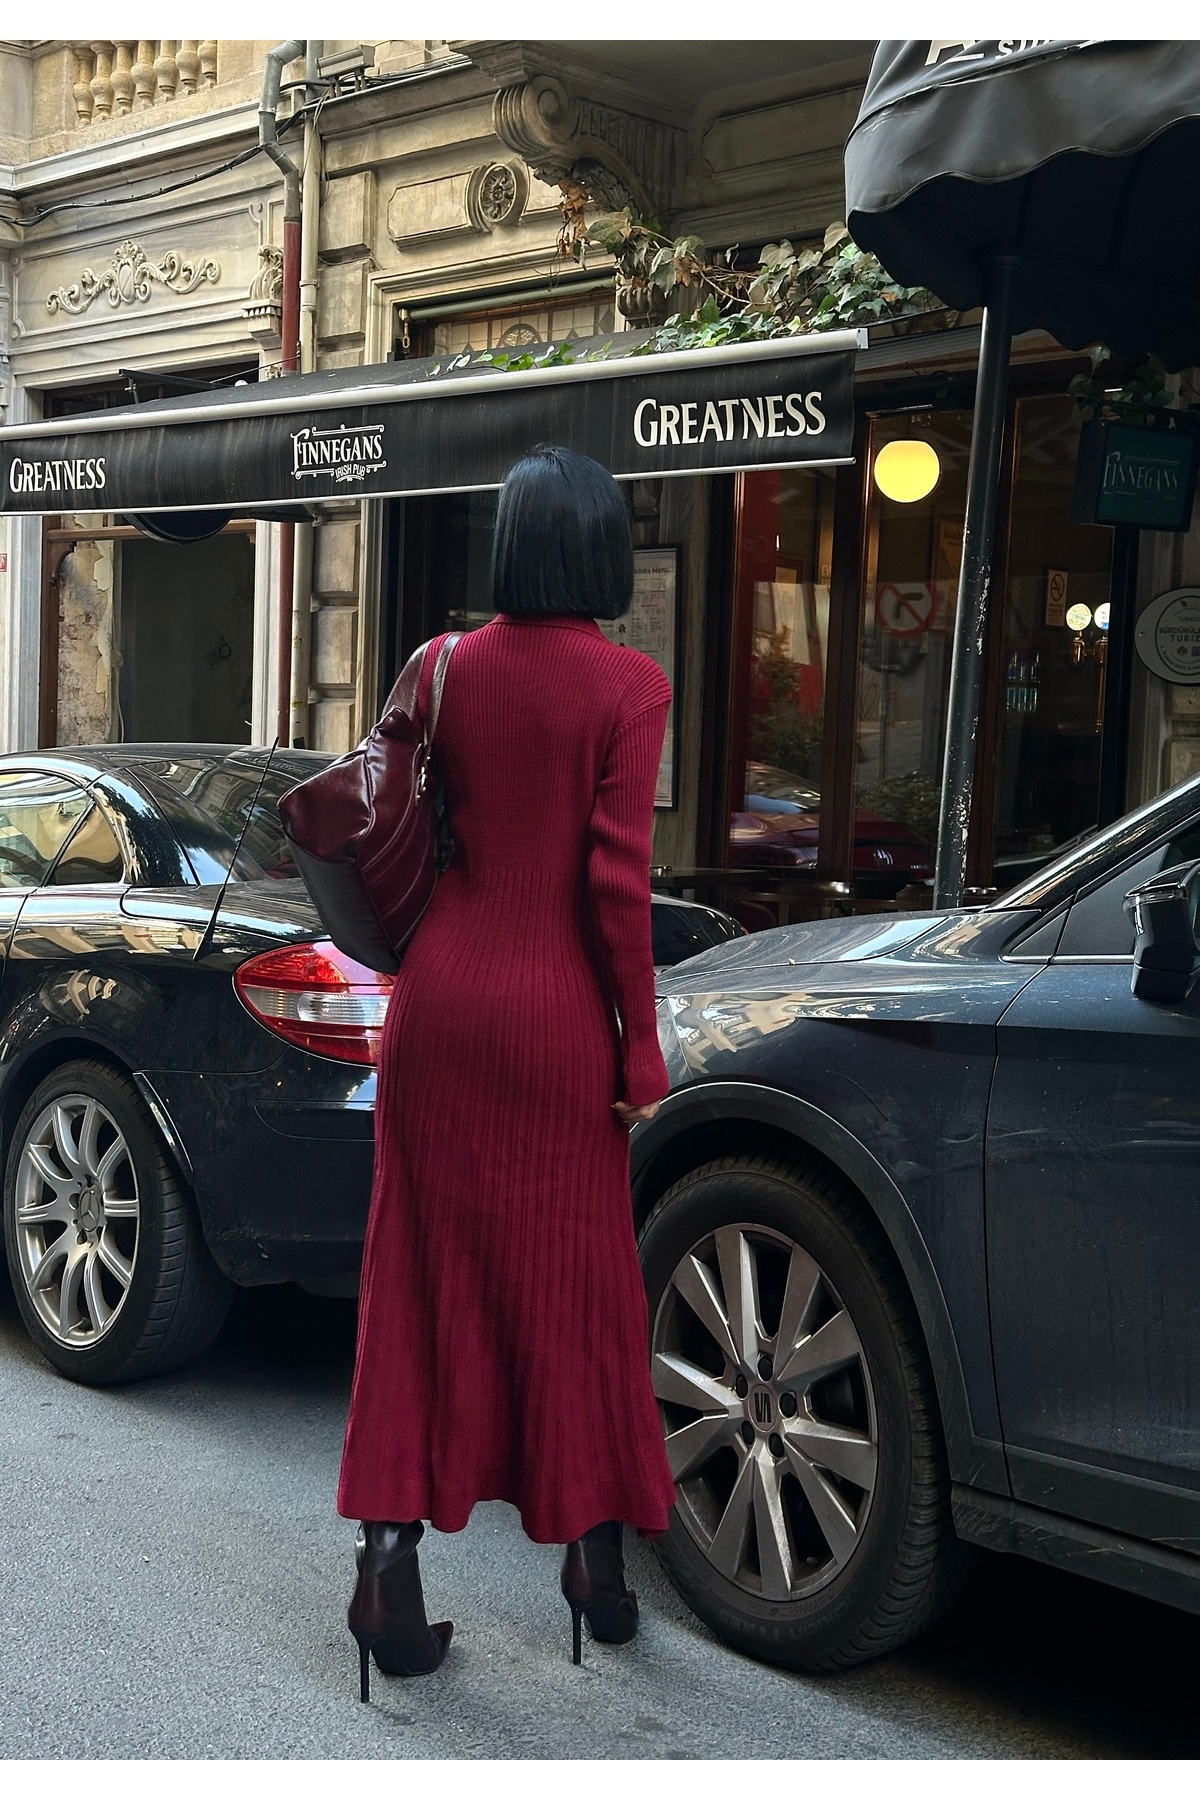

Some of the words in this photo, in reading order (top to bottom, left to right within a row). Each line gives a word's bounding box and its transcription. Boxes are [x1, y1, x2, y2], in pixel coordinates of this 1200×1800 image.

[633, 391, 826, 447] GREATNESS
[290, 428, 382, 475] FINNEGANS
[335, 464, 352, 479] IRISH
[353, 464, 366, 477] PUB
[9, 457, 106, 493] GREATNESS
